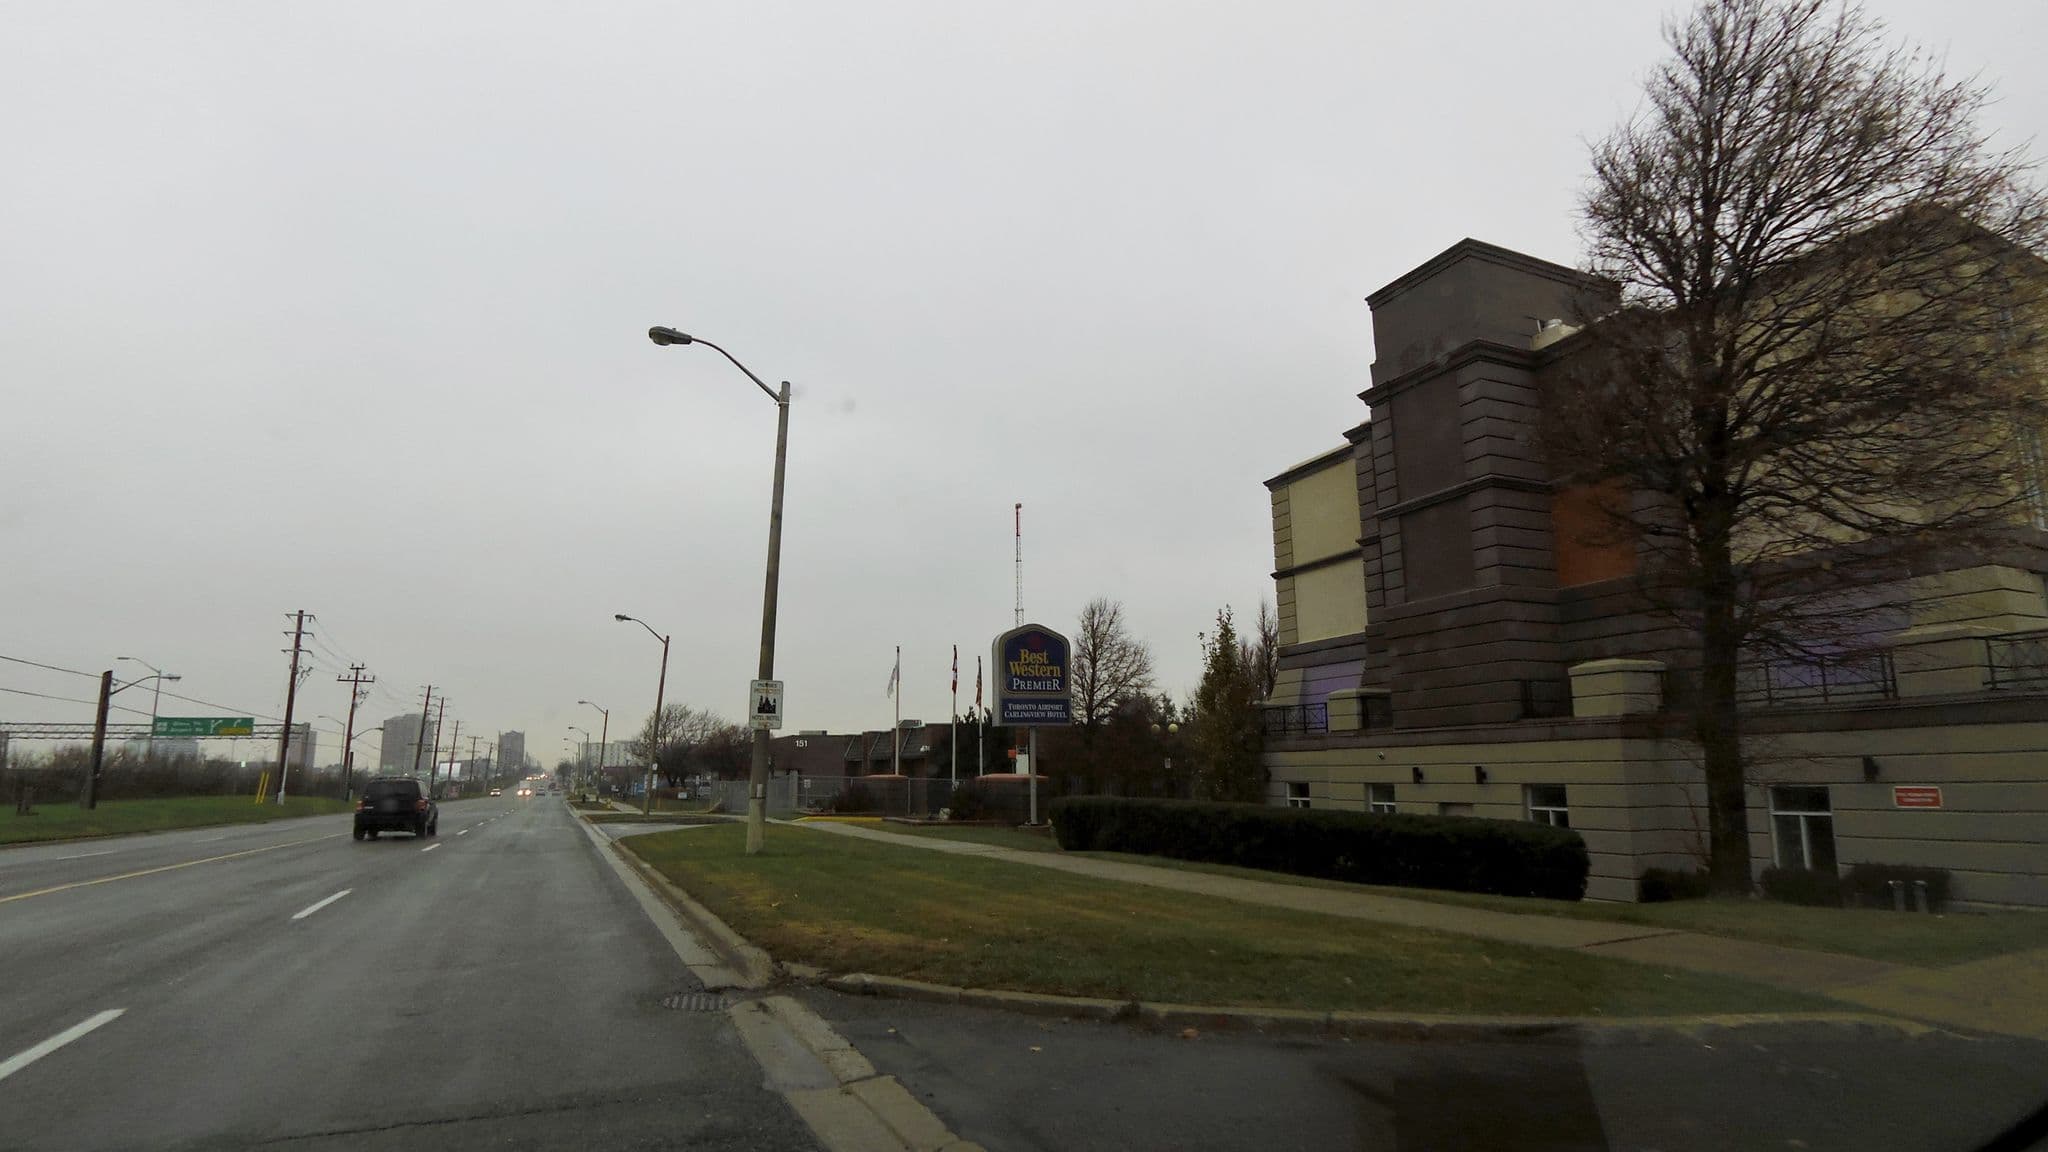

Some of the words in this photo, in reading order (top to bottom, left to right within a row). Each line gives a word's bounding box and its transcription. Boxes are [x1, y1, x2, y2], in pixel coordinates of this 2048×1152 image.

[1020, 649, 1048, 664] Best
[1009, 661, 1061, 677] Western
[1013, 678, 1061, 690] PREMIER
